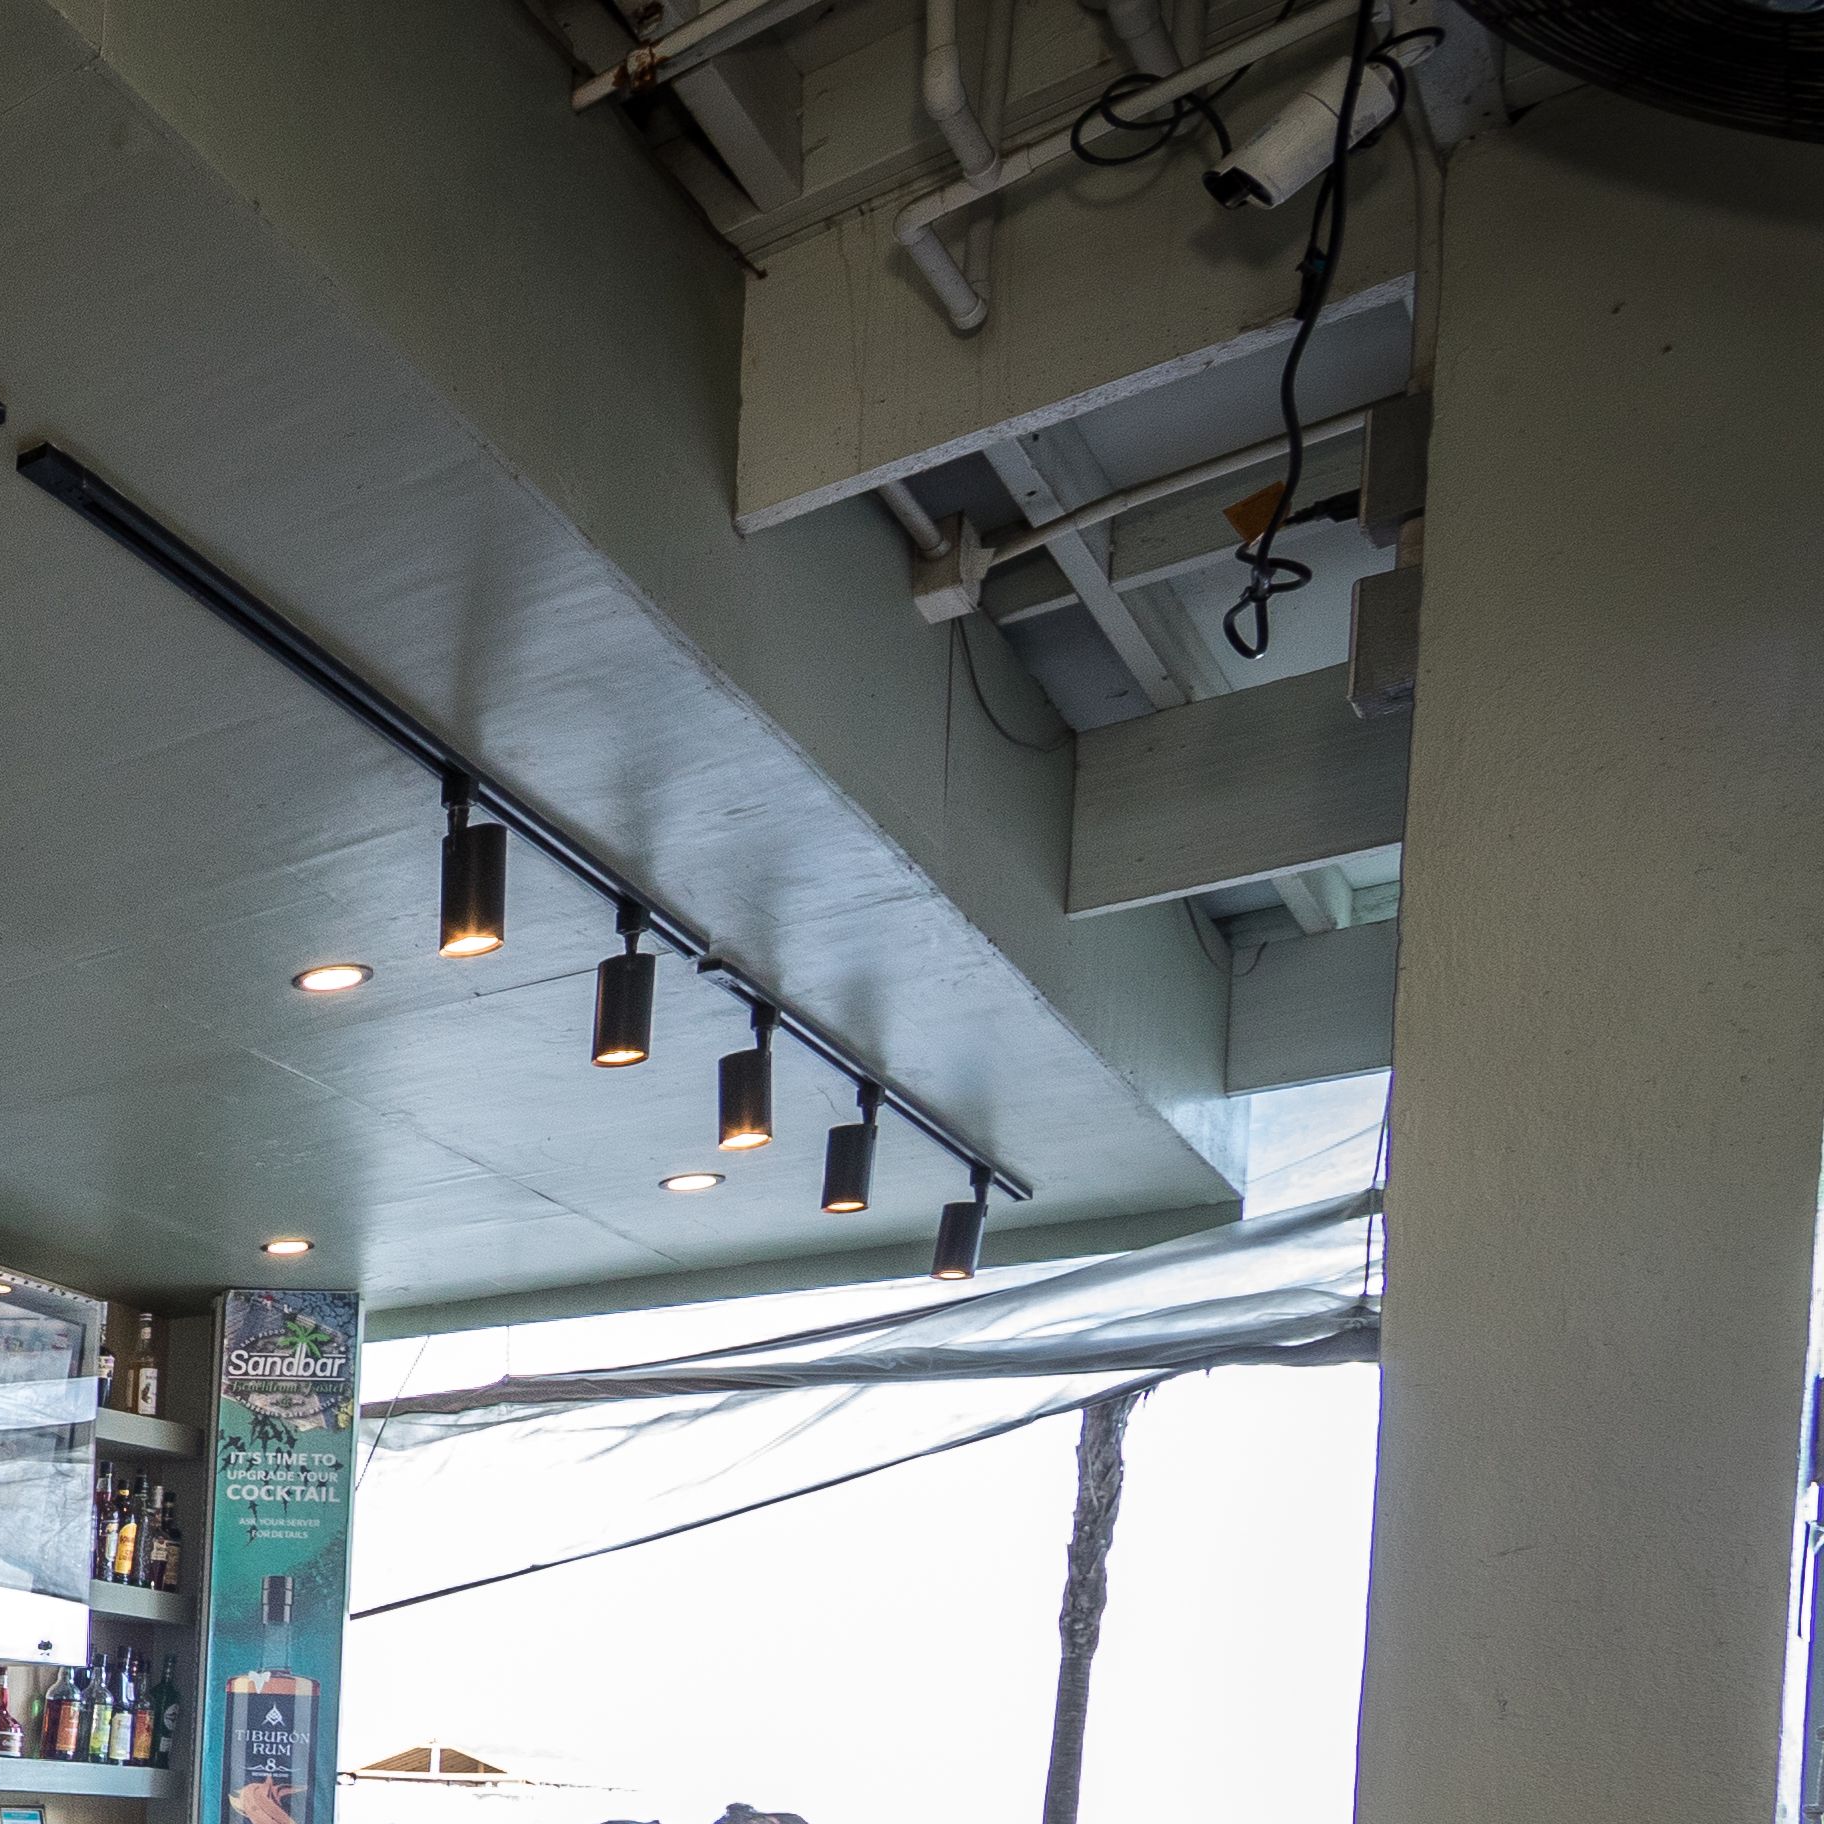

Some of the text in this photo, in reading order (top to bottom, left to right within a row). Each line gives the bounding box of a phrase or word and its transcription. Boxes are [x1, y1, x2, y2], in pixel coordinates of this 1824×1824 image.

[227, 1343, 346, 1379] Sandbar
[266, 1451, 307, 1466] TIME
[310, 1452, 336, 1467] TO
[226, 1469, 338, 1483] UPGRADE YOUR
[225, 1484, 341, 1504] COCKTAIL
[239, 1517, 320, 1529] ASK YOUR SERVER
[251, 1529, 309, 1540] FOR DETAILS
[233, 1728, 311, 1745] TIBURÓN
[252, 1743, 292, 1757] RUM
[265, 1758, 276, 1772] 8
